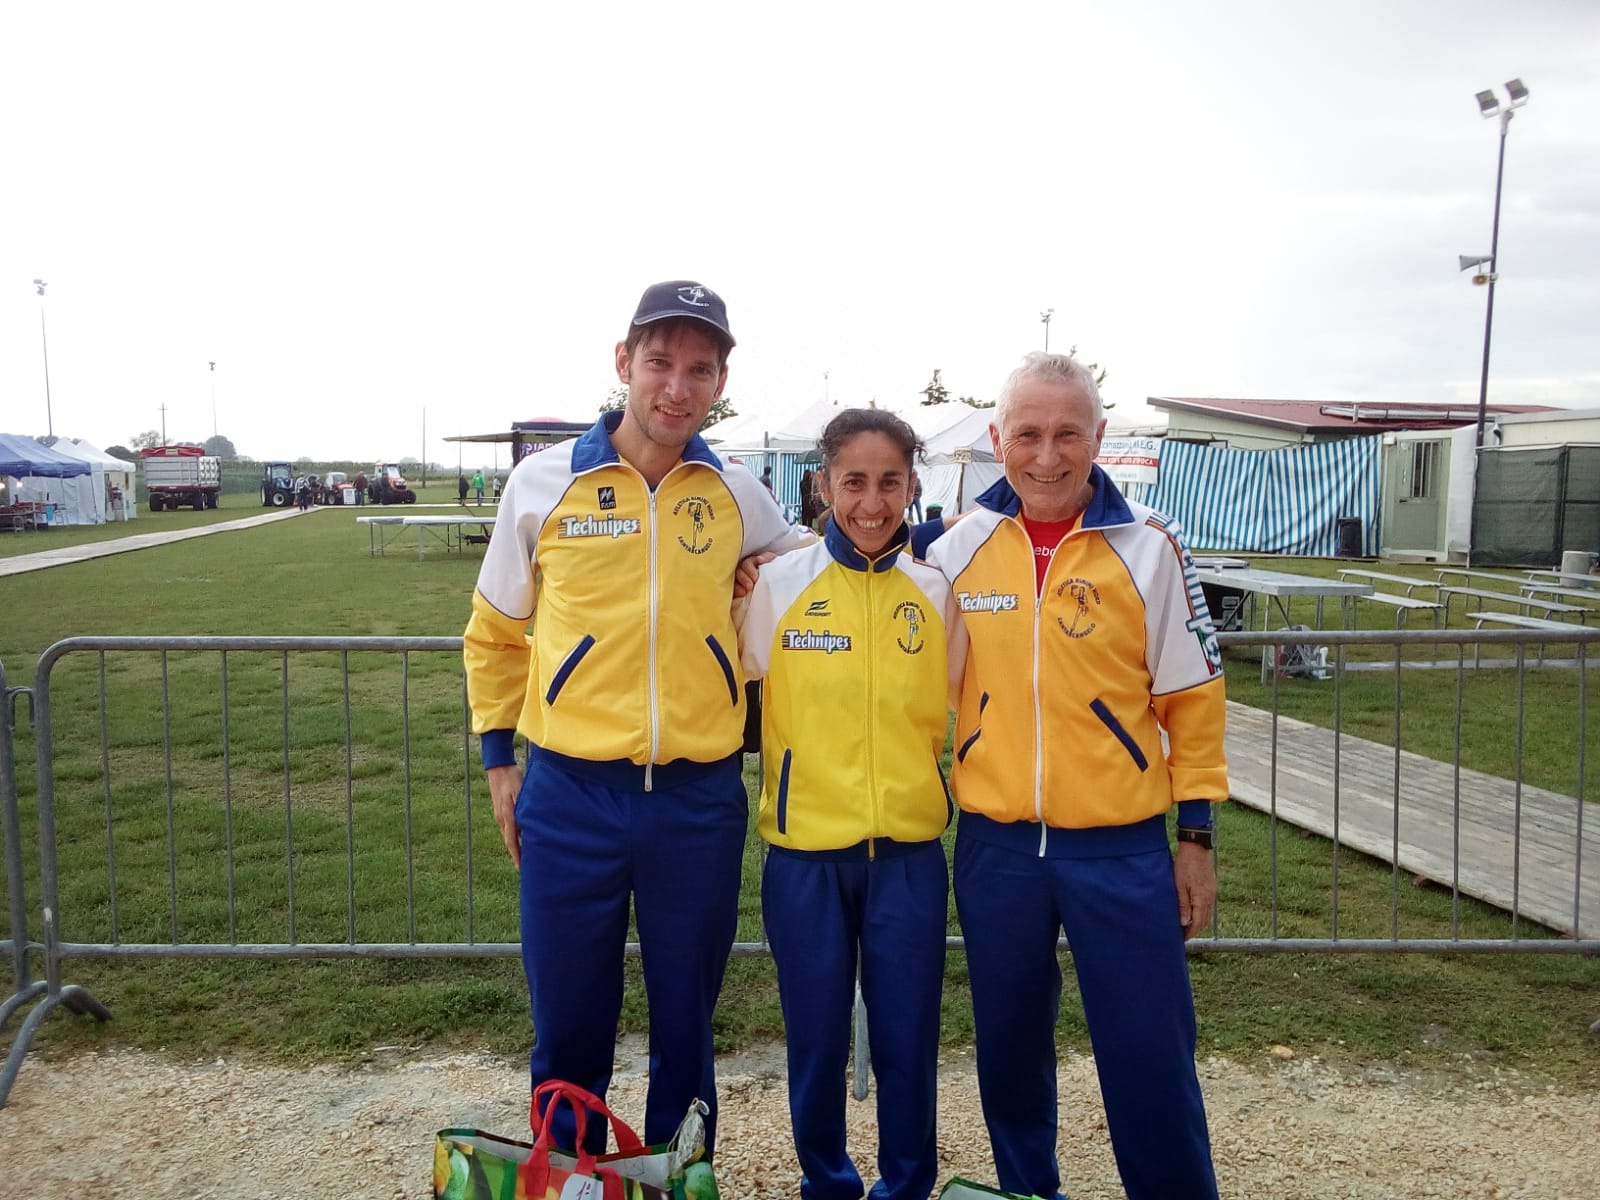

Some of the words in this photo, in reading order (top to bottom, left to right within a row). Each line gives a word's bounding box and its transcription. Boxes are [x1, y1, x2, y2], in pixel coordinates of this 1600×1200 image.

[560, 513, 640, 538] Technipes
[1034, 545, 1056, 557] ebo
[957, 589, 1018, 615] Technipes
[783, 629, 850, 654] Technipes
